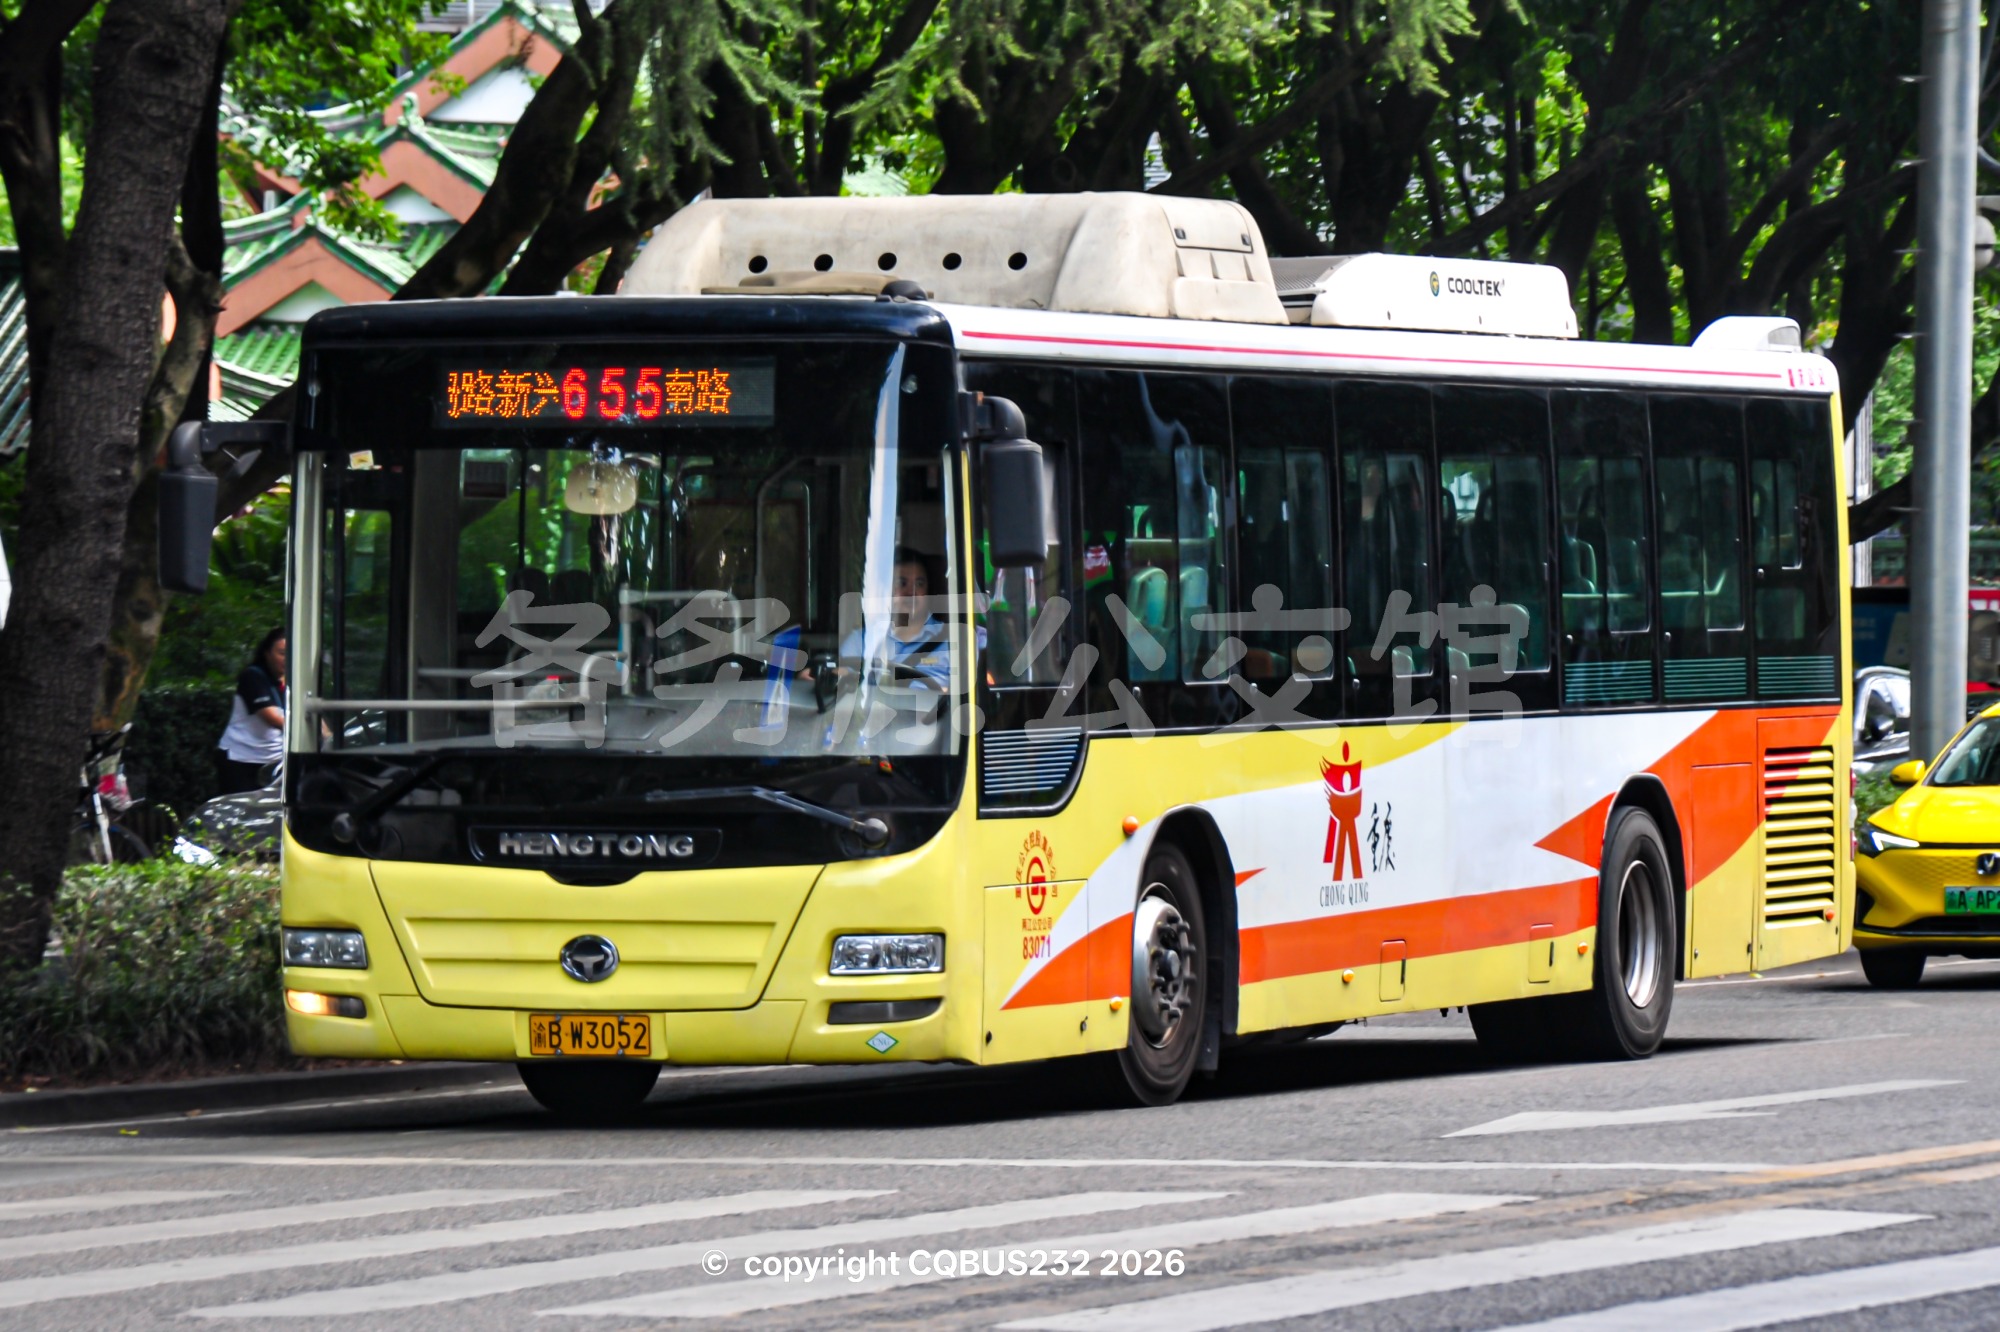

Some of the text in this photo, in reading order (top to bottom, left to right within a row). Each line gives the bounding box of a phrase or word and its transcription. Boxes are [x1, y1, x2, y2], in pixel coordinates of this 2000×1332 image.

[1447, 277, 1502, 297] COOLTEK
[562, 367, 662, 420] 655
[499, 831, 694, 857] HENGTONG
[1319, 882, 1369, 907] CHONG QING
[1022, 934, 1051, 960] 83071
